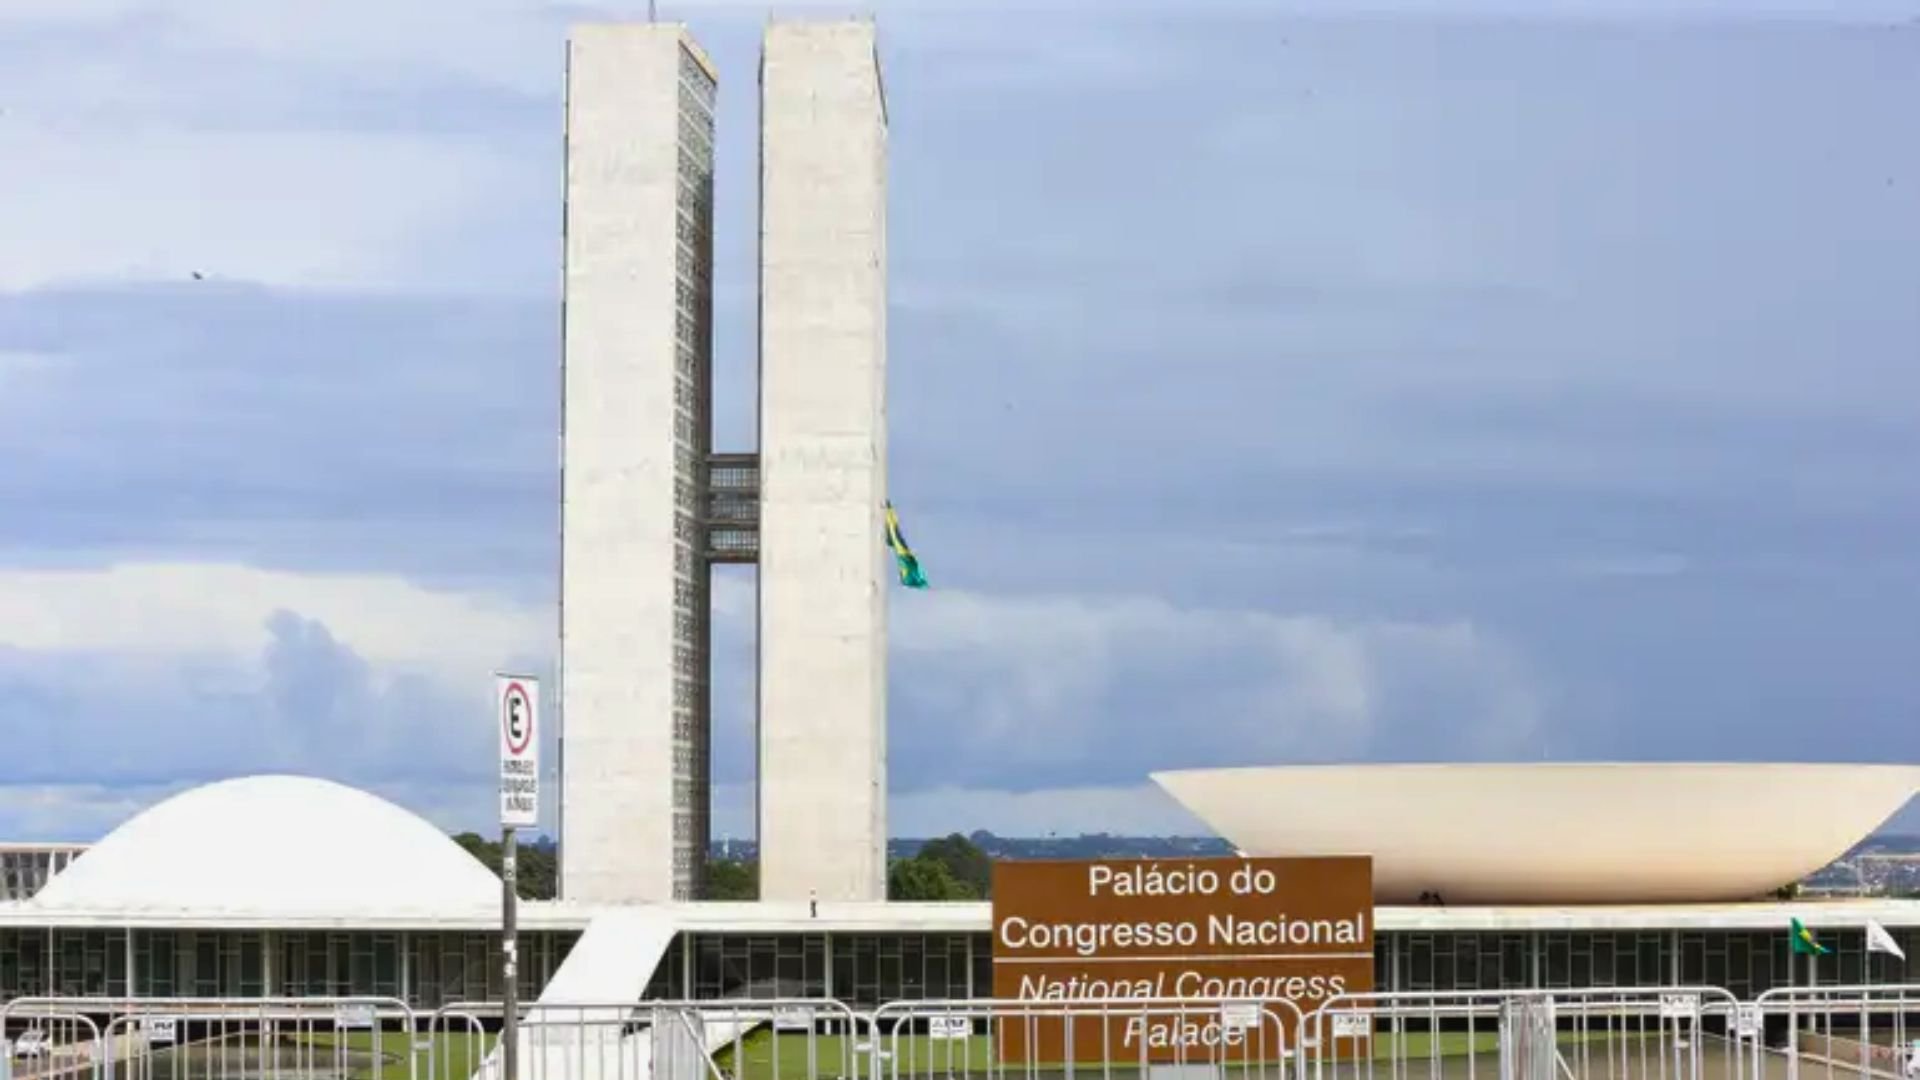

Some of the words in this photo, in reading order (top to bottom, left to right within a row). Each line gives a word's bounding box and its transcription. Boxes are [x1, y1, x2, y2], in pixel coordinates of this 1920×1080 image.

[509, 697, 522, 739] E
[1088, 863, 1219, 896] Palácio
[1230, 863, 1277, 895] do
[1000, 916, 1198, 955] Congresso
[1207, 914, 1365, 945] Nacional
[1018, 971, 1166, 1001] National
[1175, 970, 1346, 1001] Congress
[1123, 1014, 1244, 1048] Palace
